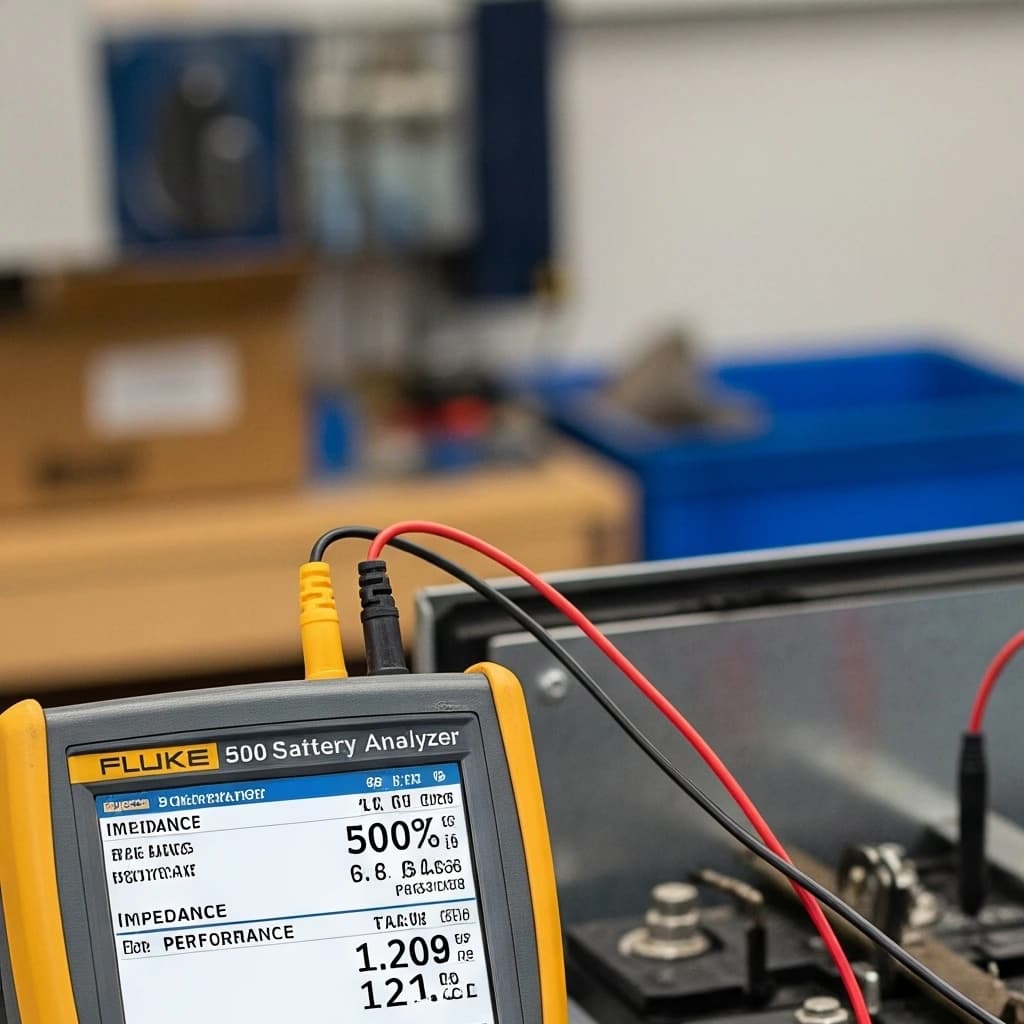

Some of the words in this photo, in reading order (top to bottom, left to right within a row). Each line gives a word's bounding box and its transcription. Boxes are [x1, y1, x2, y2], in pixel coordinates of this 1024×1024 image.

[100, 749, 210, 775] FLUKE
[225, 743, 267, 764] 500
[364, 729, 460, 753] Analyzer
[346, 816, 441, 855] 500%
[117, 903, 228, 929] IMPEDANCE
[355, 934, 451, 973] 1.209
